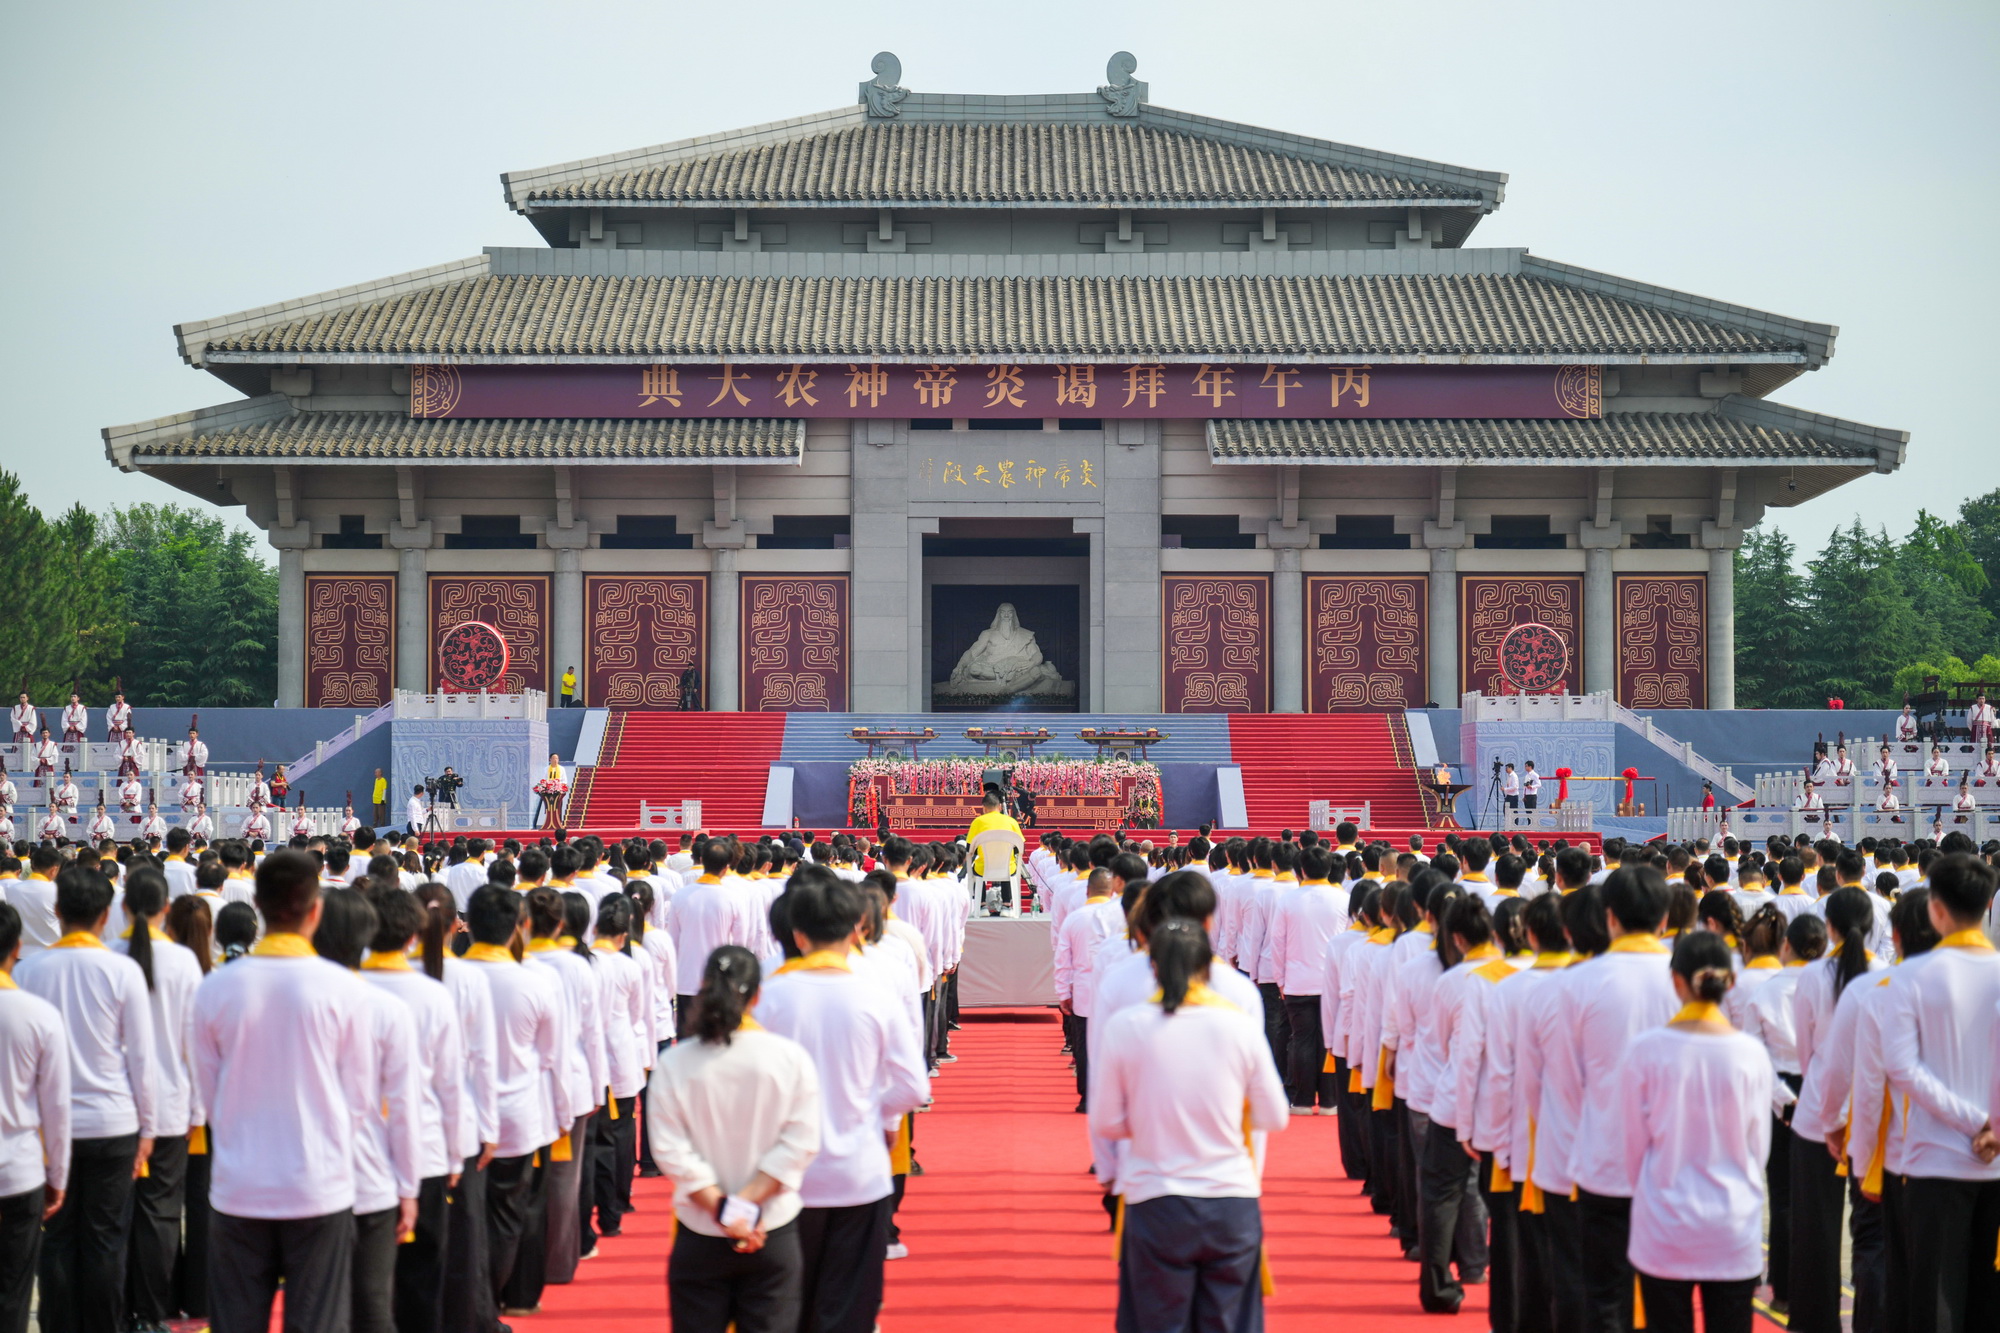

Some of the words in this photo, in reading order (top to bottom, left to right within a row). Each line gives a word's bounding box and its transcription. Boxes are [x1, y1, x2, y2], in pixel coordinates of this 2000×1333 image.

[638, 364, 1373, 408] 丙午年拜谒炎帝神农大典
